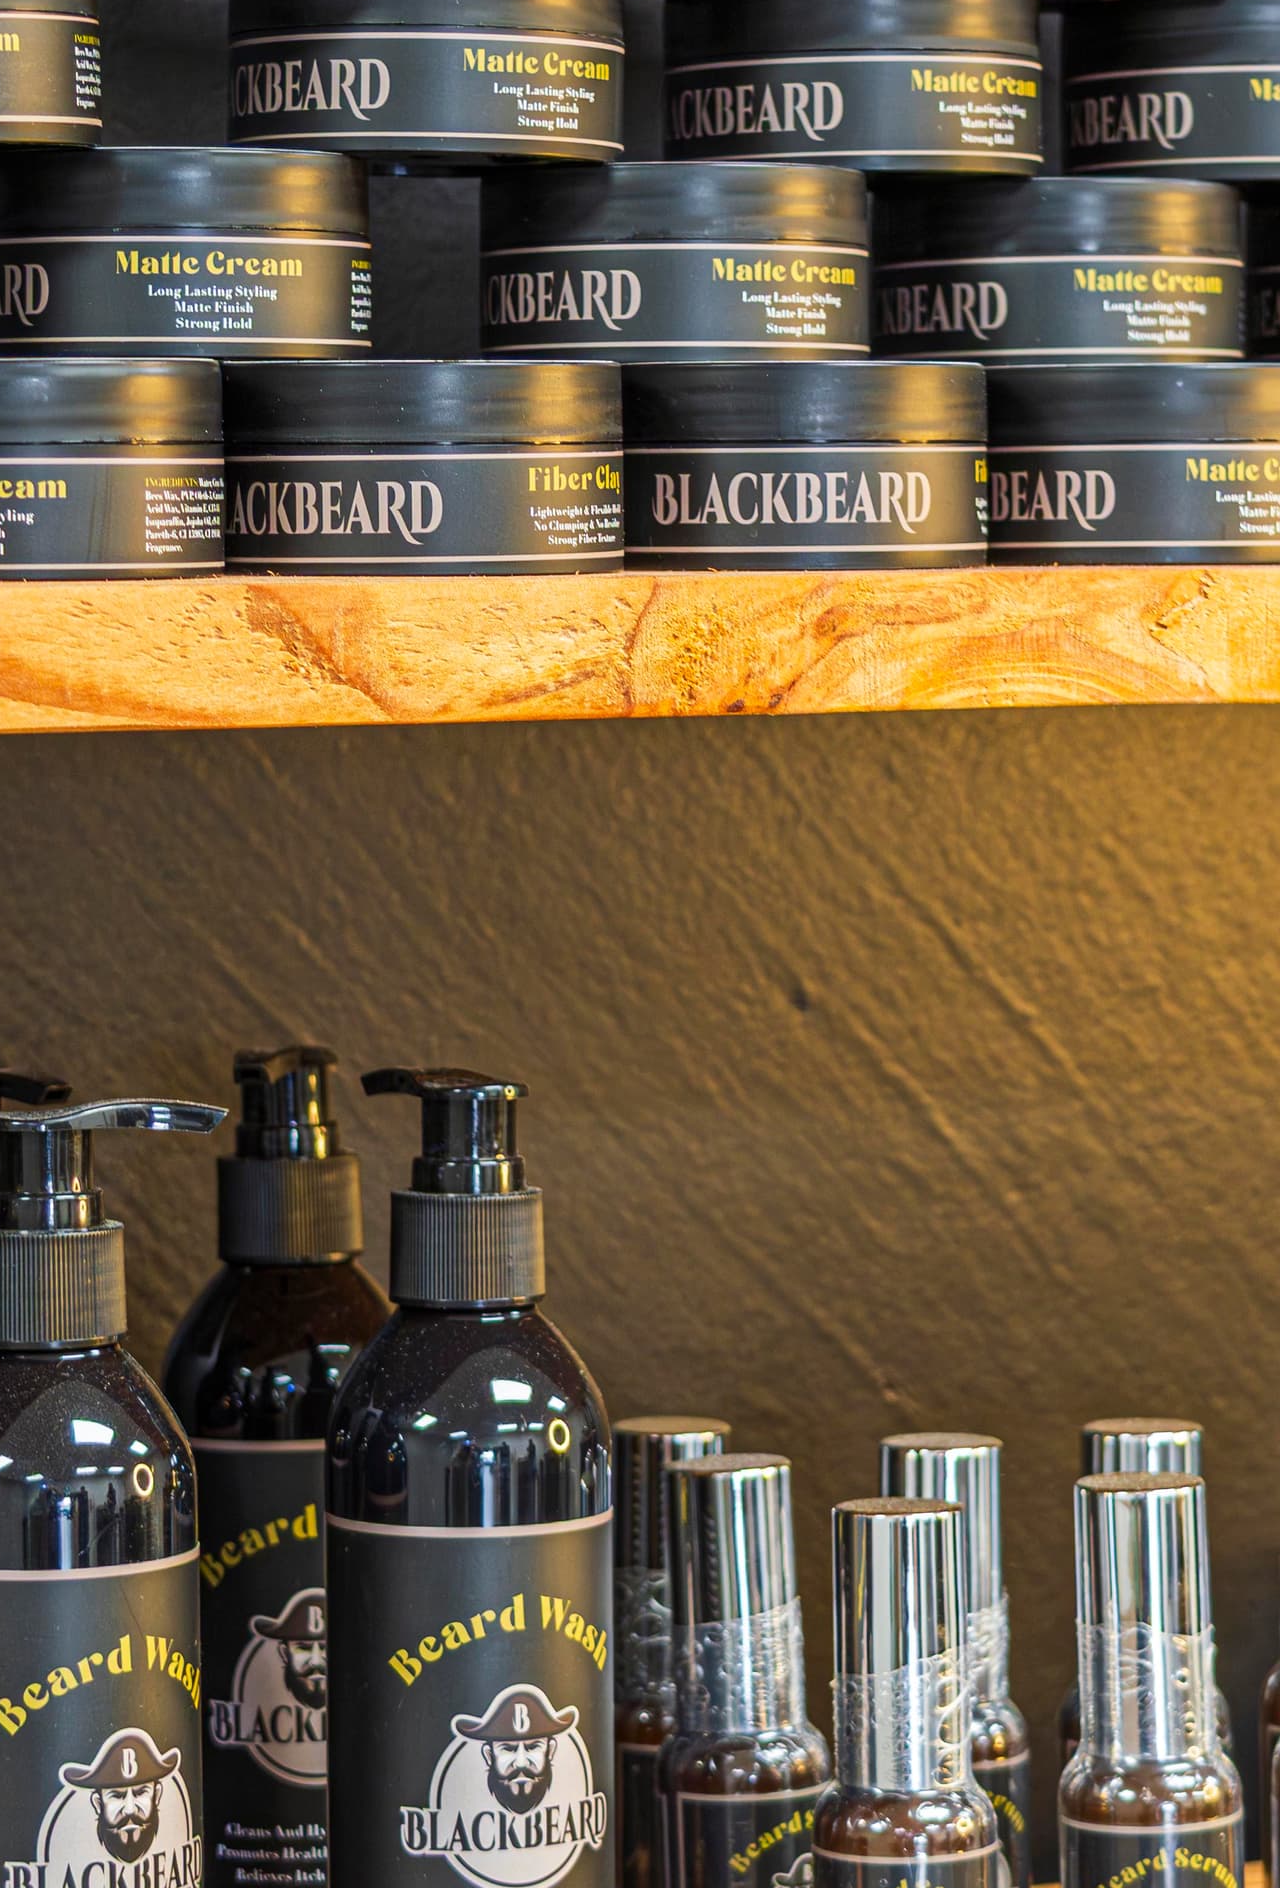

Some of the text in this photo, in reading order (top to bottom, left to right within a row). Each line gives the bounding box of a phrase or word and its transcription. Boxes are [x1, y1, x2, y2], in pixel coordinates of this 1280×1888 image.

[463, 48, 610, 81] Matte Cream
[912, 69, 979, 94] Matte
[115, 250, 304, 277] Matte Cream
[712, 258, 855, 286] Matte Cream
[148, 284, 278, 301] Long Lasting Styling
[1074, 268, 1223, 294] Matte Cream
[174, 300, 254, 314] Matte Finish
[175, 316, 253, 332] Strong Hold
[528, 464, 620, 495] Fiber Clay
[1185, 457, 1260, 482] Matte
[652, 471, 931, 534] BLACKBEARD
[388, 1593, 608, 1688] Beard Wash
[402, 1793, 607, 1853] BLACKBEARD
